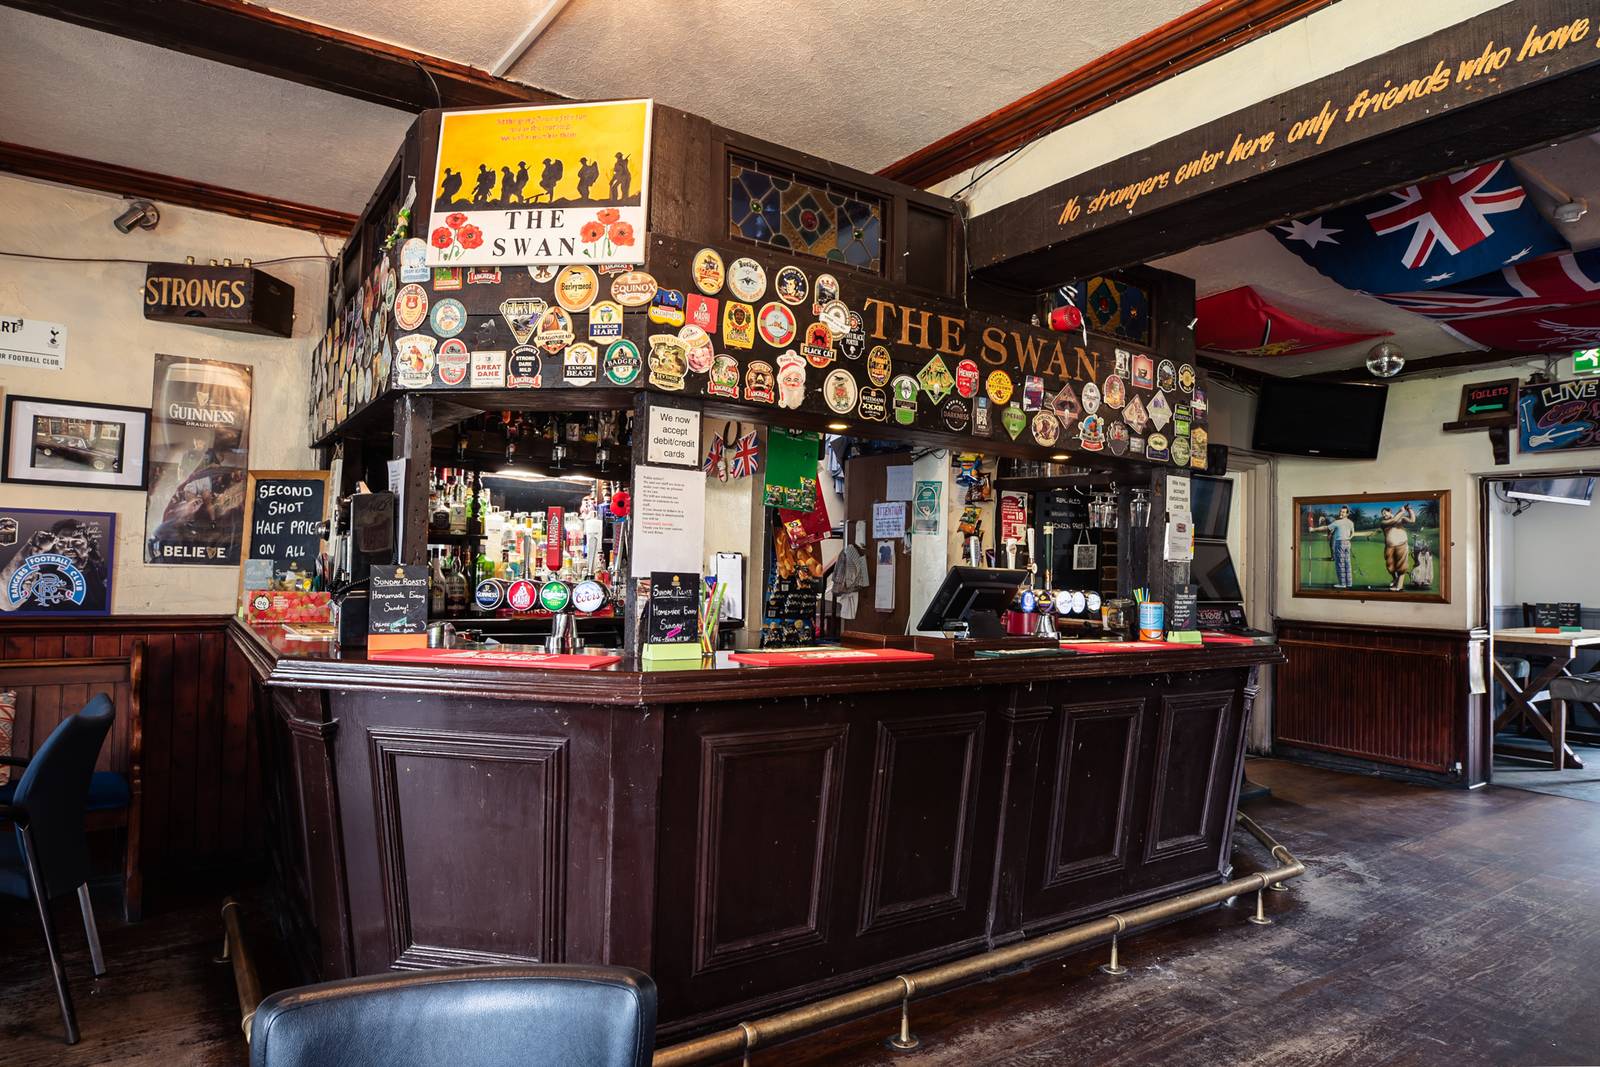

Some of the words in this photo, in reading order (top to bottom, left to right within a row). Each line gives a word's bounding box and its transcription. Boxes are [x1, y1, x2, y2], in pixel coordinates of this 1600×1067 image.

[1058, 195, 1081, 225] No
[1087, 171, 1170, 215] strangers
[1174, 150, 1225, 185] enter
[1226, 133, 1276, 165] here
[1287, 100, 1340, 145] only
[1345, 61, 1452, 122] friends
[1455, 41, 1511, 83] who
[1516, 17, 1590, 63] have
[505, 210, 565, 230] THE
[492, 237, 576, 257] SWAN
[146, 276, 247, 309] STRONGS
[612, 283, 656, 296] EQUINOX
[592, 328, 619, 336] HART
[863, 297, 966, 356] THE
[980, 326, 1100, 387] SWAN
[803, 346, 822, 356] BLACK
[822, 349, 834, 358] CAT
[8, 354, 41, 364] FOOTBALL
[42, 358, 60, 366] CLUB
[607, 359, 639, 368] BADGER
[565, 369, 594, 378] BEAST
[958, 368, 979, 379] HENRY'S
[1471, 387, 1509, 401] TOILETS
[1541, 379, 1600, 407] LIVE
[861, 402, 884, 412] XXXB
[169, 403, 236, 425] GUINNESS
[660, 413, 673, 423] We
[674, 415, 691, 425] now
[976, 416, 988, 426] IPA
[662, 427, 688, 437] accept
[653, 436, 696, 449] debit/credit
[663, 449, 685, 459] cards
[259, 484, 314, 500] SECOND
[268, 501, 305, 517] SHOT
[1015, 512, 1024, 521] 18
[256, 520, 286, 535] HALF
[259, 543, 276, 556] ON
[285, 545, 306, 558] ALL
[29, 556, 69, 566] FOOTBALL
[11, 566, 29, 599] RANGERS
[69, 569, 84, 592] CLUB
[575, 592, 601, 604] Coors
